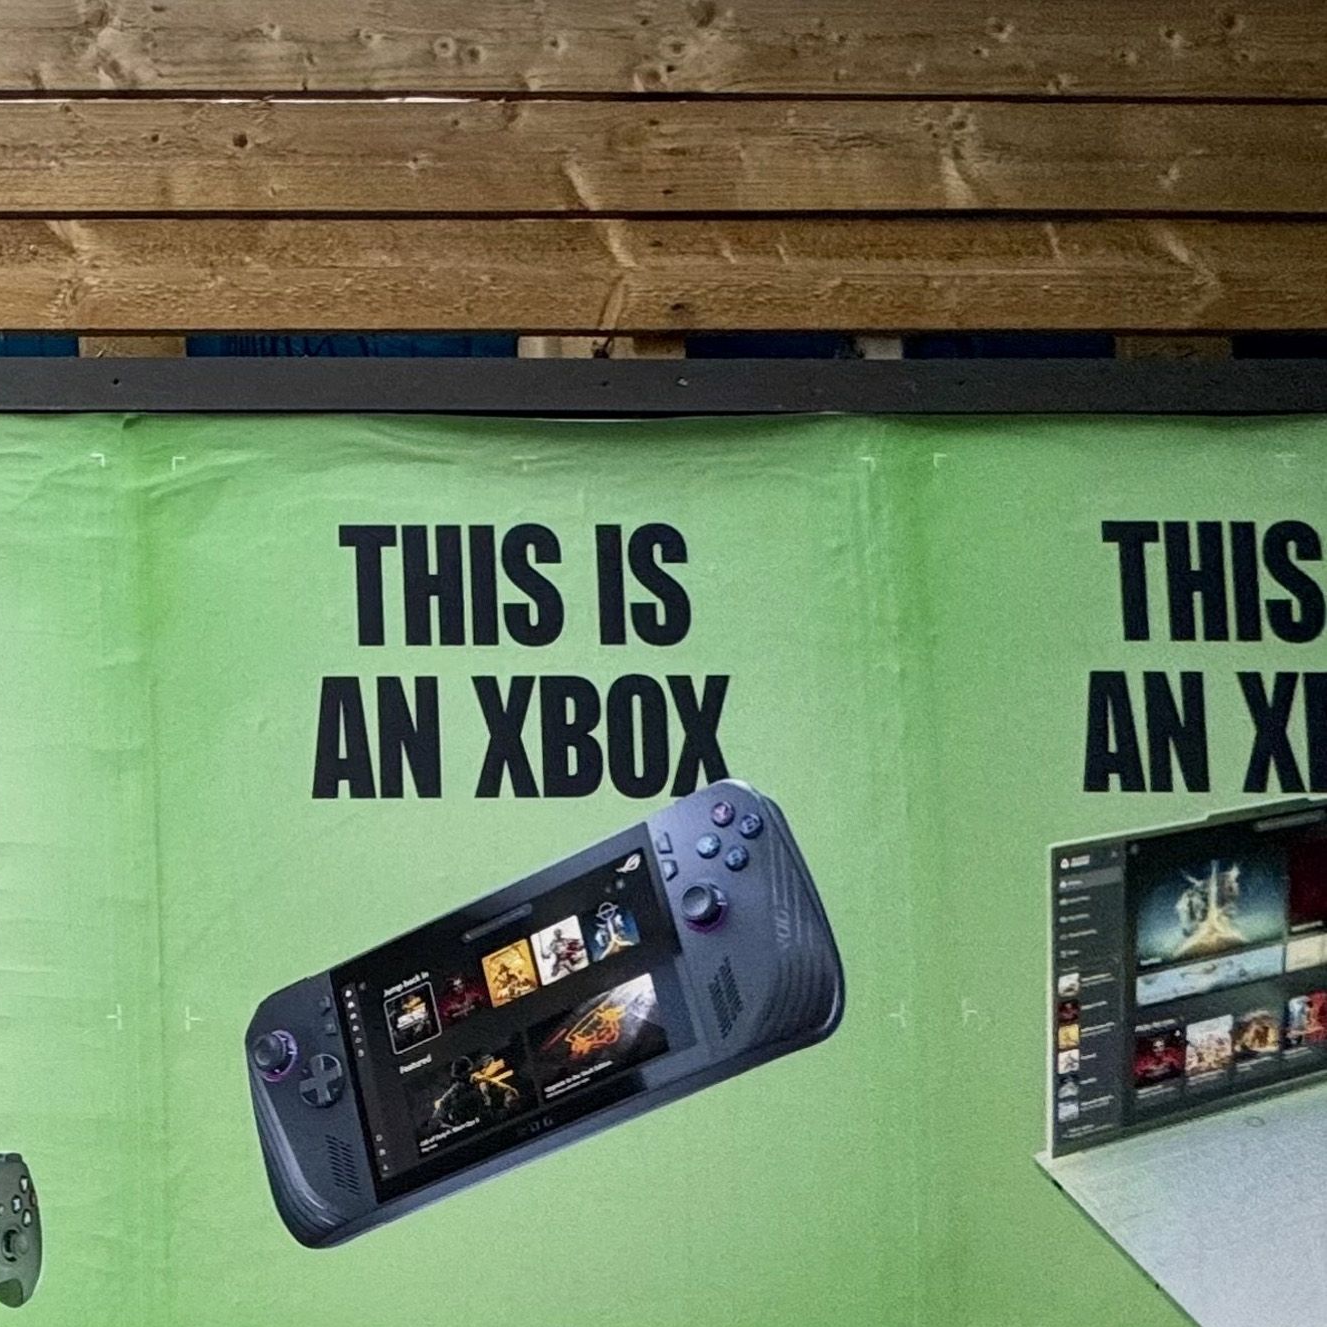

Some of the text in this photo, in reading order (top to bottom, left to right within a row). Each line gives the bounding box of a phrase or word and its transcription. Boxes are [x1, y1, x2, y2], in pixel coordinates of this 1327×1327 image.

[338, 522, 692, 647] THIS IS
[1101, 519, 1327, 645] THIS
[311, 673, 731, 799] AN XBOX
[1083, 670, 1211, 794] AN
